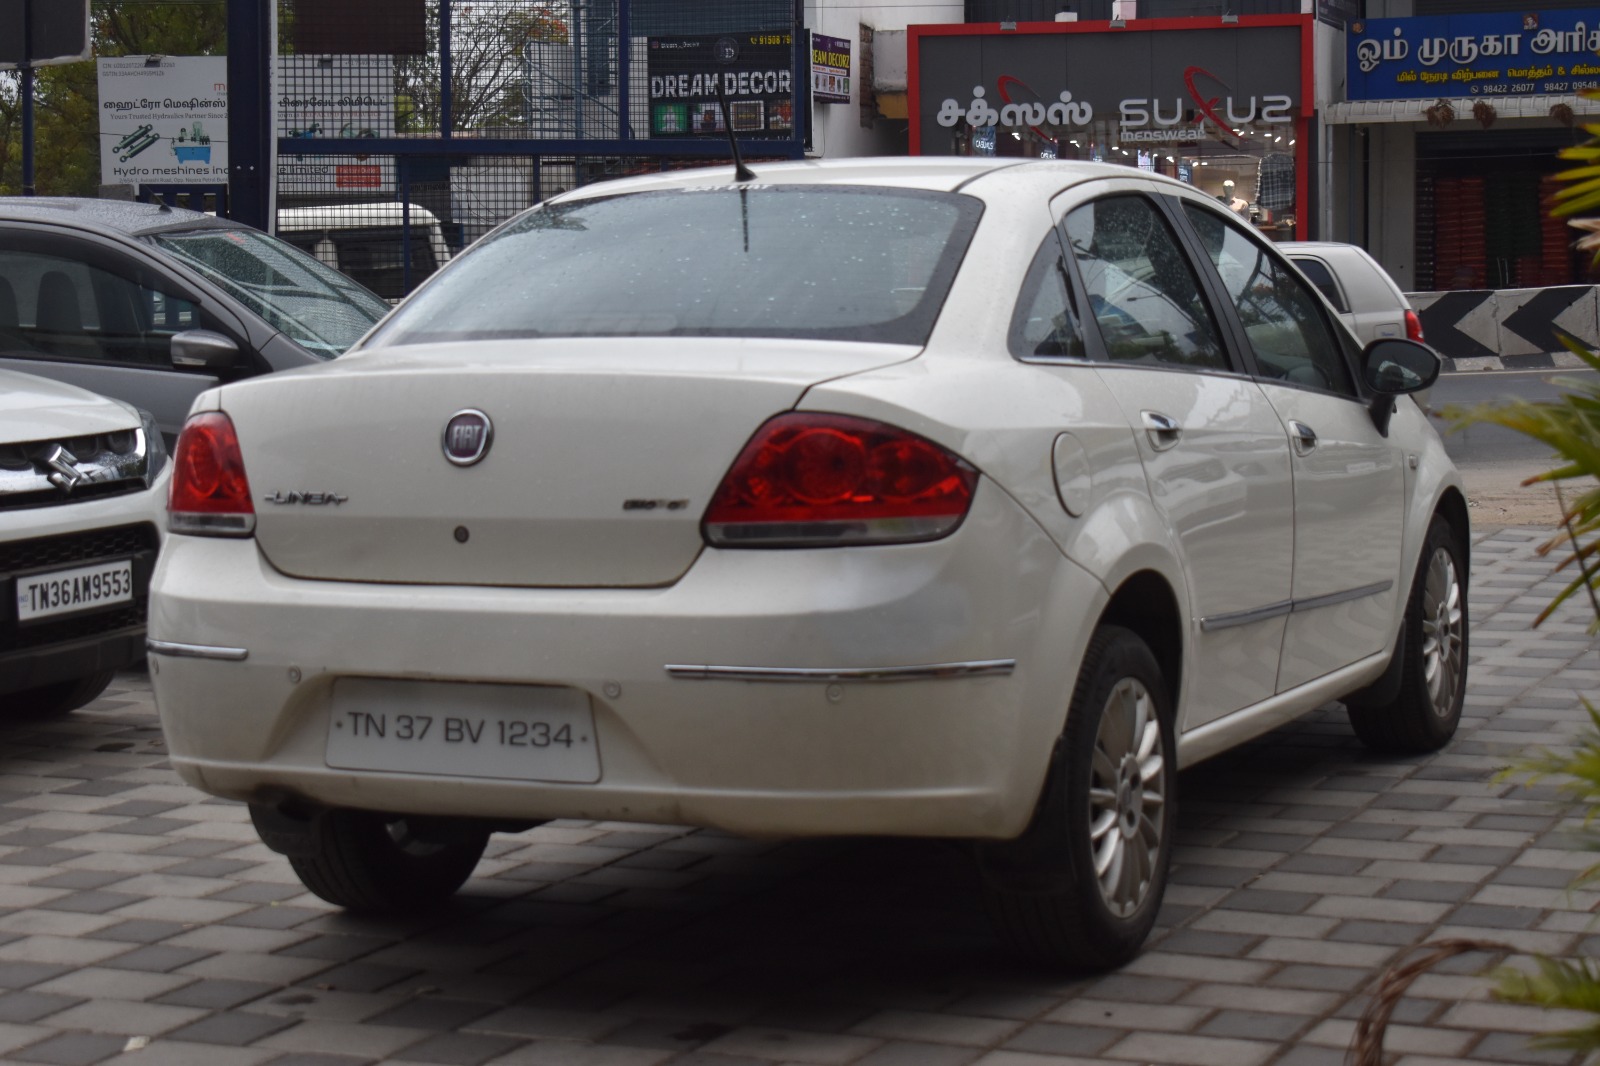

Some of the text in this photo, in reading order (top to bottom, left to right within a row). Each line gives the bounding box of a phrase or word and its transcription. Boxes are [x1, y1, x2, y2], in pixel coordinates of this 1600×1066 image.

[1357, 27, 1408, 72] ஓம்
[1417, 34, 1521, 66] முருகா
[651, 73, 719, 98] DREAM
[1397, 70, 1417, 82] மில்
[1420, 71, 1448, 83] நேரடி
[1452, 68, 1499, 82] விற்பனை
[1557, 66, 1566, 75] &
[1483, 84, 1507, 93] 98422
[1511, 83, 1535, 92] 26077
[1544, 82, 1568, 91] 98427
[937, 86, 1093, 127] சக்ஸஸ்
[114, 166, 149, 177] Hydro
[152, 166, 209, 174] meshines
[453, 425, 481, 449] FIAT
[264, 491, 348, 504] LINEA
[29, 569, 130, 610] TN36AM9553
[347, 712, 574, 747] TN 37 BV 1234
